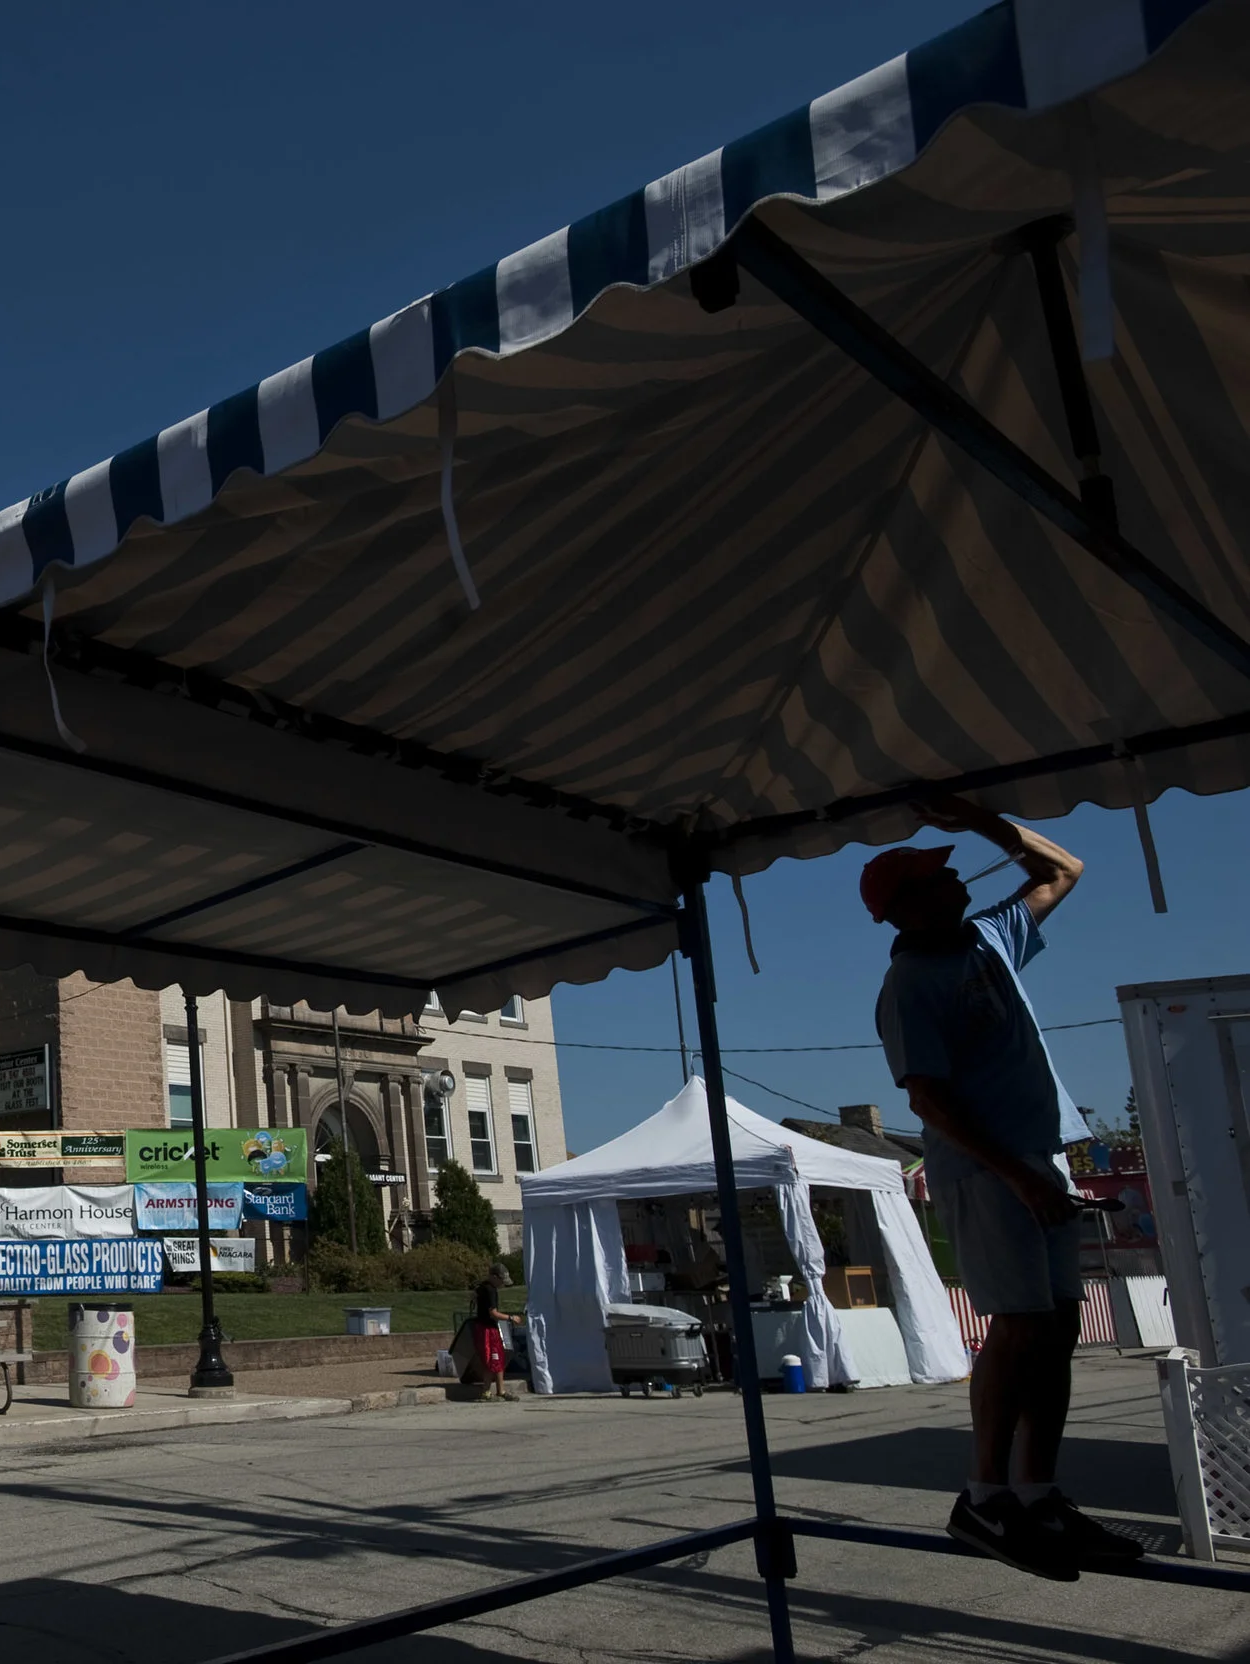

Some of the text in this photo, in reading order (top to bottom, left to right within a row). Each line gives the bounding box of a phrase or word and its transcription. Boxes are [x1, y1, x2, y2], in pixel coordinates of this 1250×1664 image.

[6, 1138, 57, 1149] Somerset
[6, 1149, 37, 1157] Trust
[64, 1145, 122, 1155] Anniversary
[386, 1174, 405, 1183] CENTER
[244, 1192, 295, 1204] Standard
[6, 1205, 133, 1220] Harmon House
[267, 1204, 296, 1215] Bank
[30, 1222, 62, 1230] CENTER
[173, 1240, 195, 1251] GREAT
[92, 1242, 163, 1274] PRODUCTS
[167, 1252, 195, 1265] THINGS
[218, 1251, 253, 1259] NIAGARA
[34, 1276, 64, 1291] FROM
[66, 1275, 102, 1290] PEOPLE
[104, 1274, 128, 1289] WHO
[130, 1274, 162, 1289] CARE"
